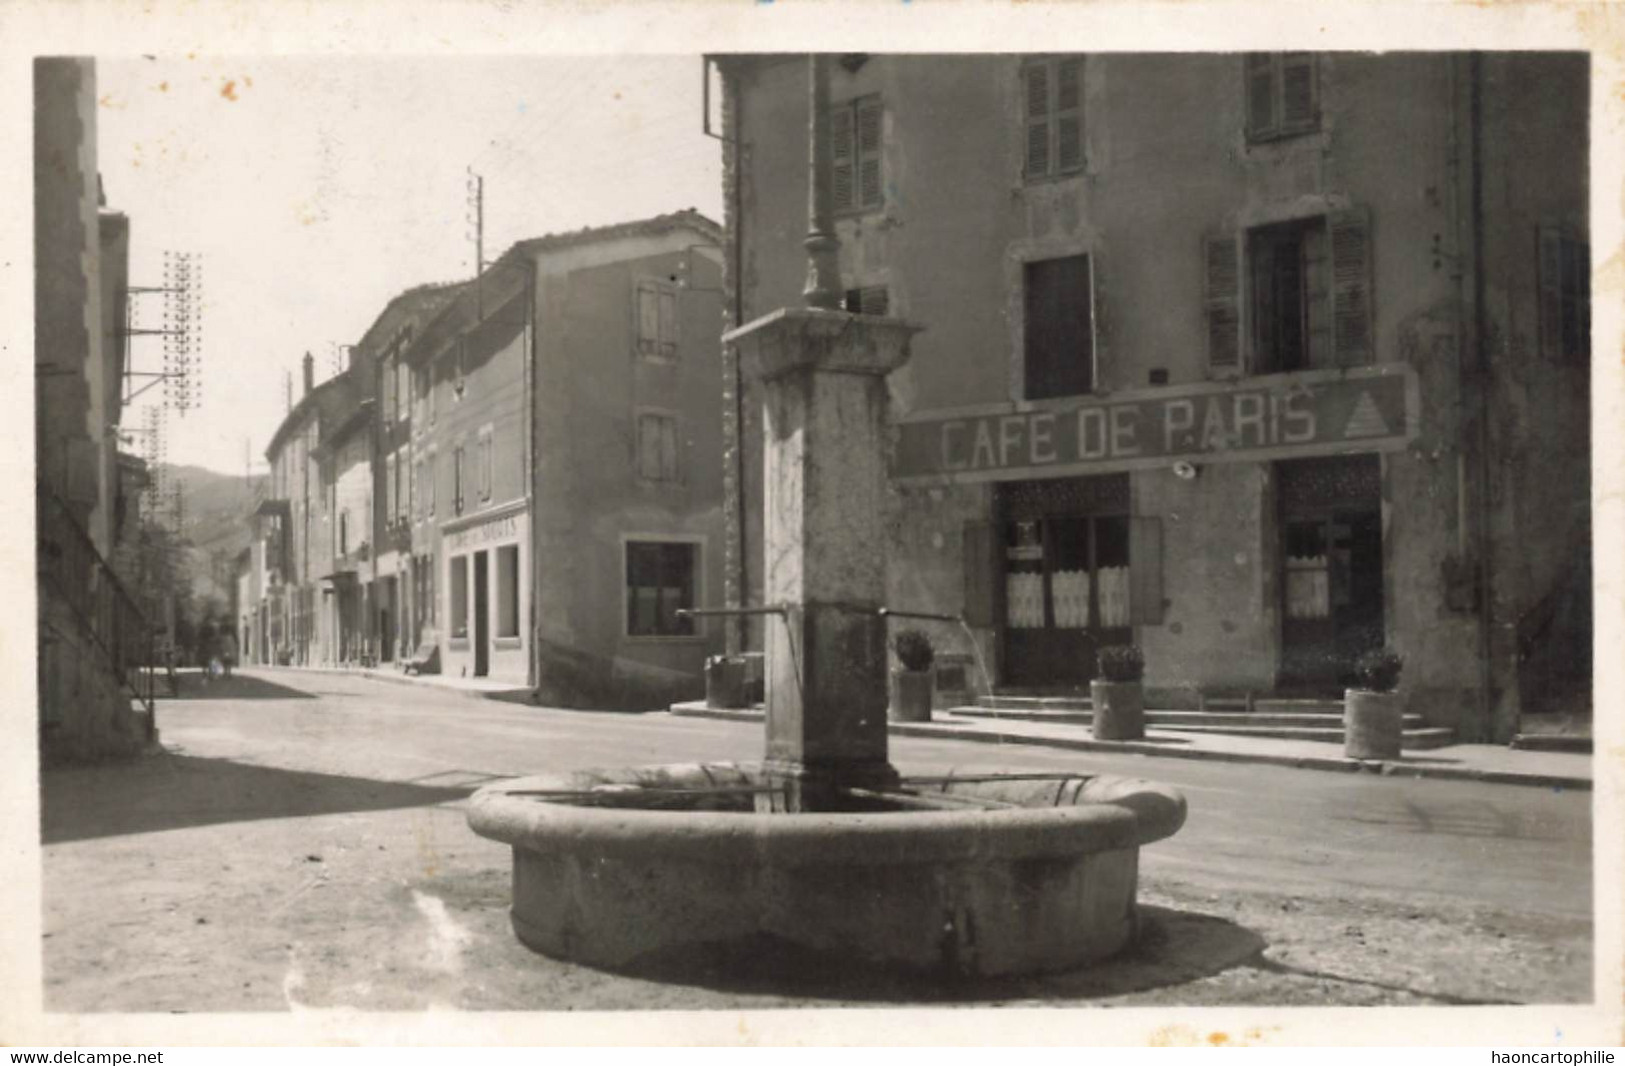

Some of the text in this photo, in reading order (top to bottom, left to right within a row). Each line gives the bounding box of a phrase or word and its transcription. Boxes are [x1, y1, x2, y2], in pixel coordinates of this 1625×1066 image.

[941, 391, 1316, 470] CAFE DE PARIS
